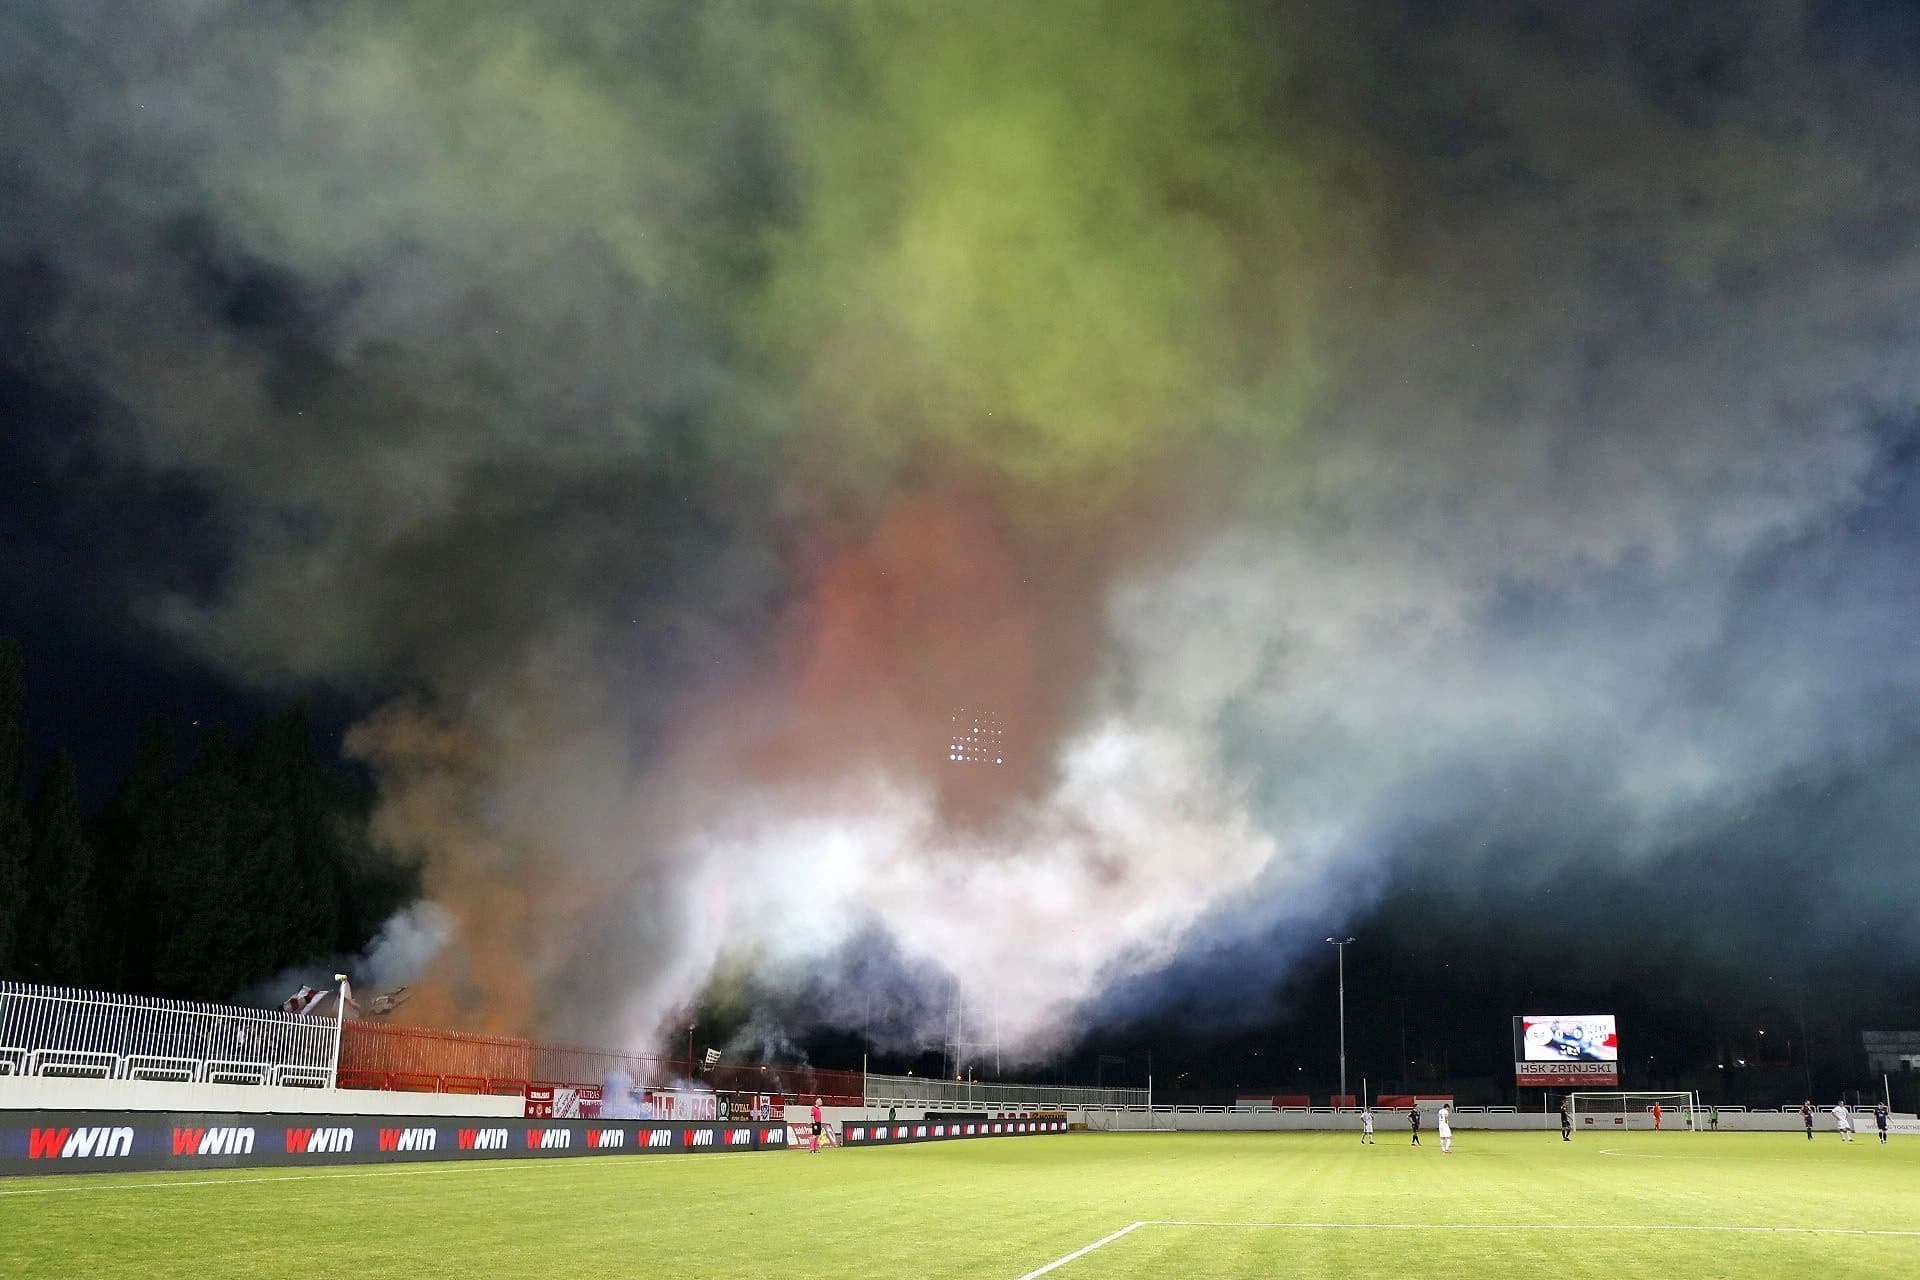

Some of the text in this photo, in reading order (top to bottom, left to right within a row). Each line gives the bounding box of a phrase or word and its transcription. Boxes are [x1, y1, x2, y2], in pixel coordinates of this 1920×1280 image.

[1520, 1062, 1611, 1073] HŠK ZRINJSKI
[730, 1103, 750, 1113] LOYAL
